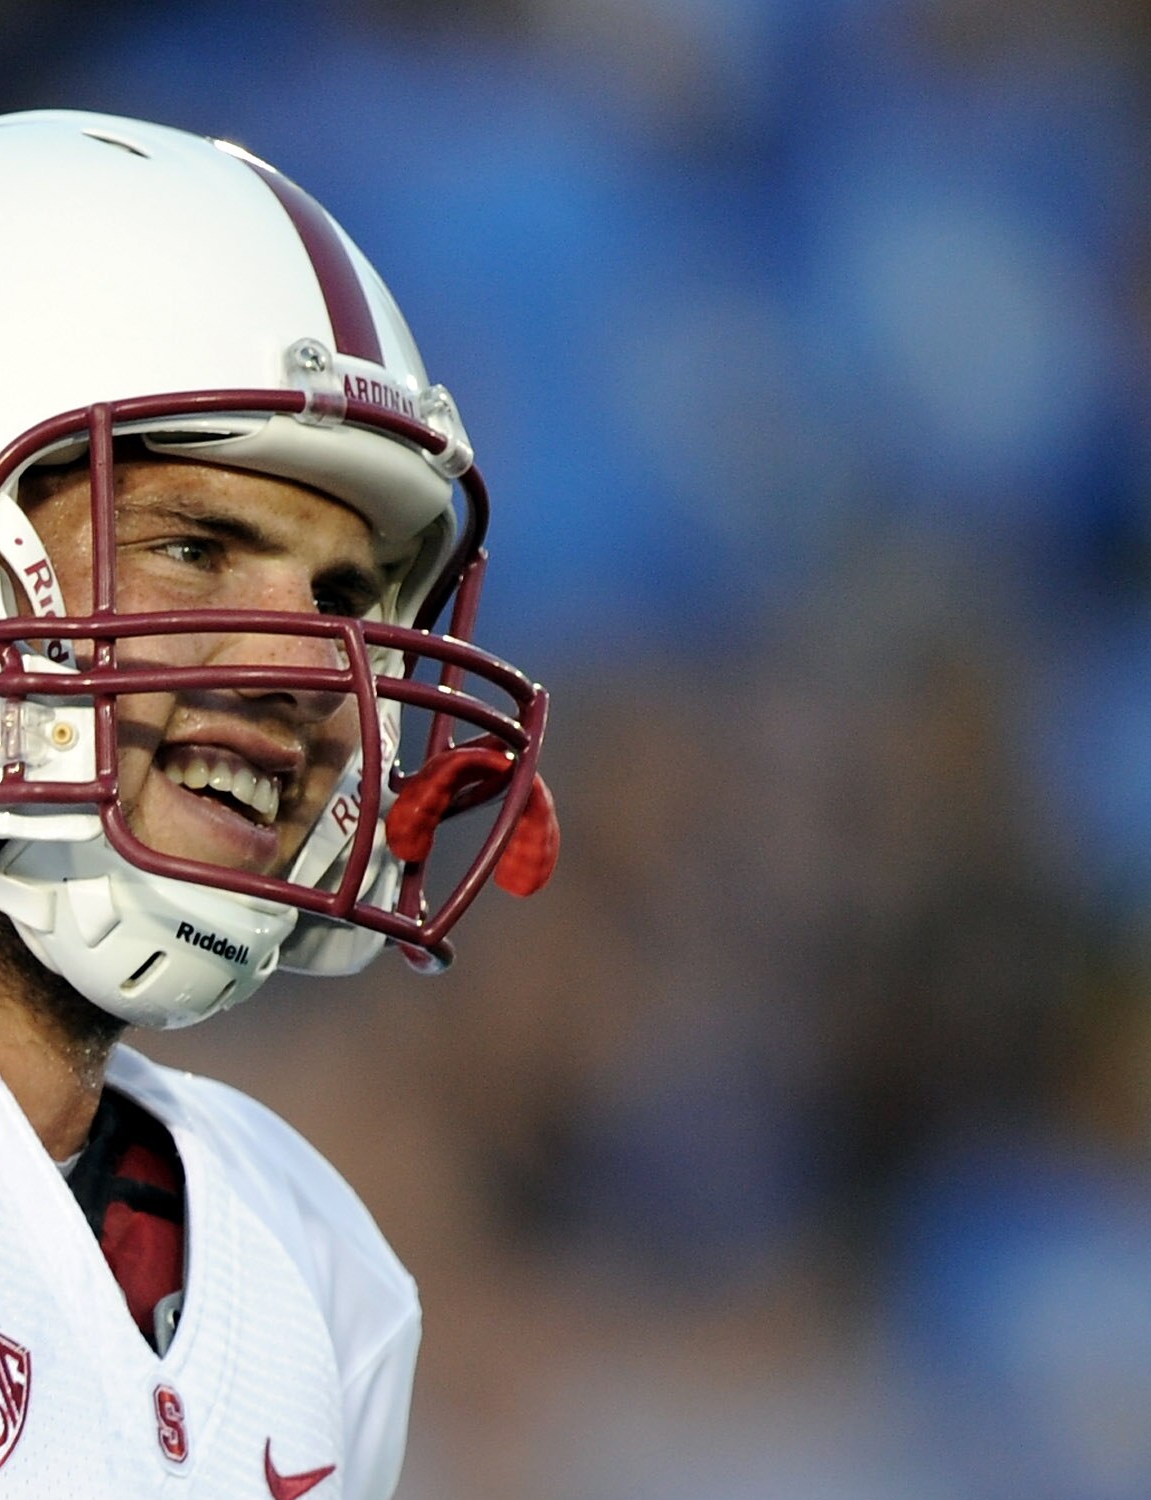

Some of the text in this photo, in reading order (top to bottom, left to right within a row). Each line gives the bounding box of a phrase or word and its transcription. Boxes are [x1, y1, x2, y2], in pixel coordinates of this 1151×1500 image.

[343, 373, 415, 419] ARDINAL
[175, 921, 249, 965] Riddell
[153, 1383, 189, 1463] S
